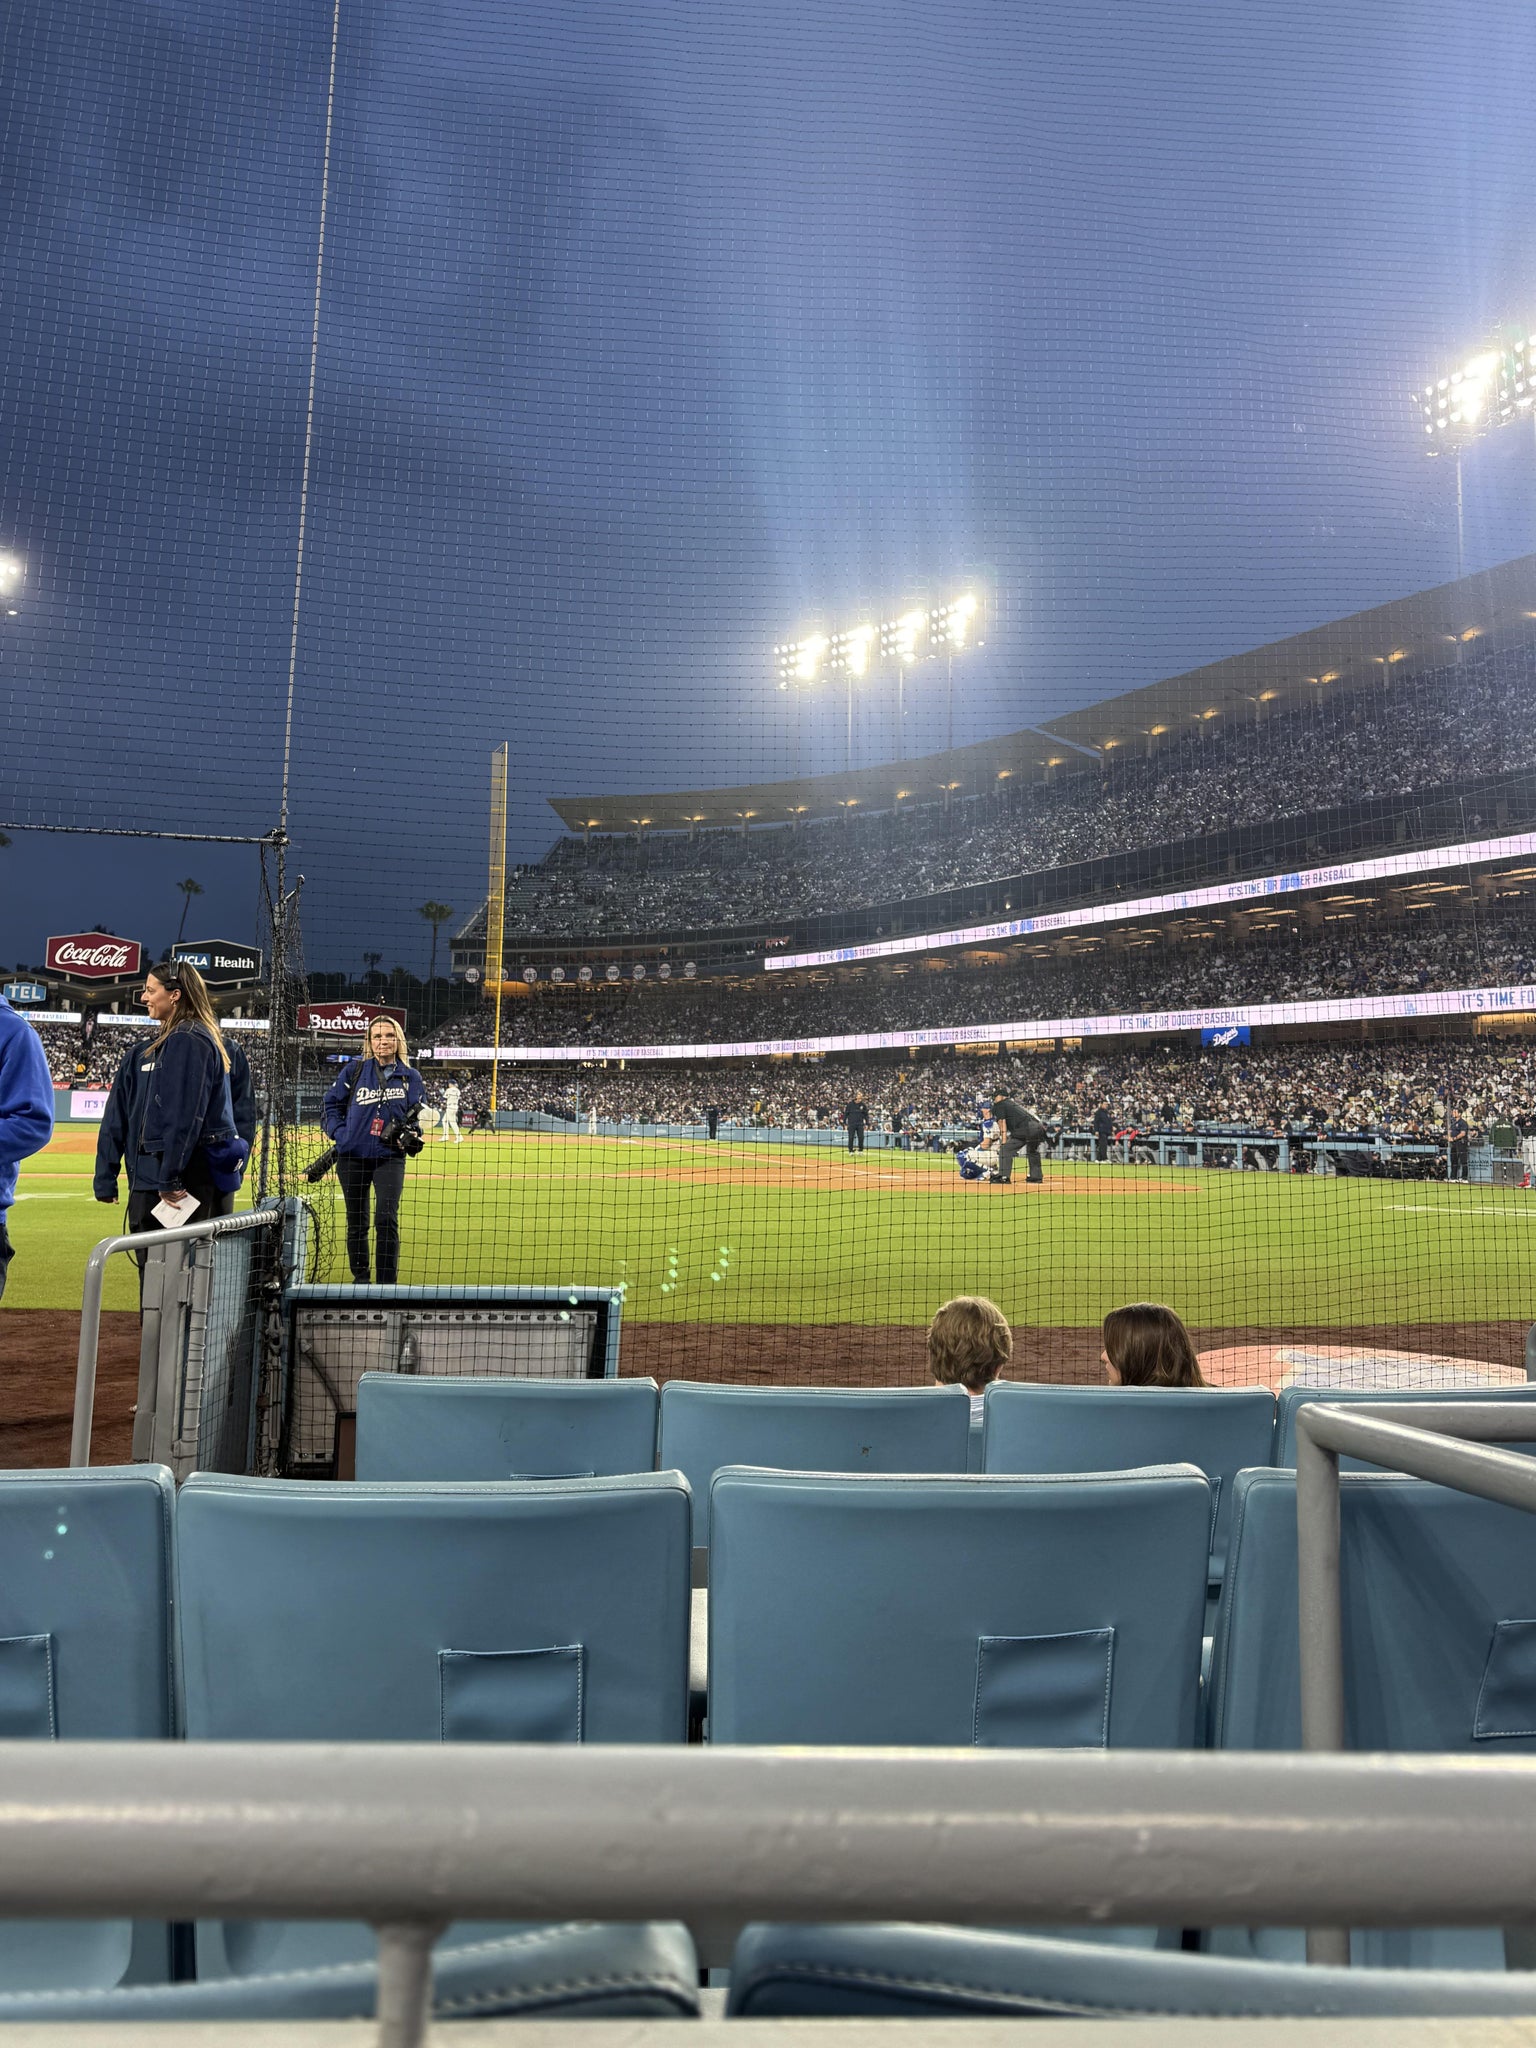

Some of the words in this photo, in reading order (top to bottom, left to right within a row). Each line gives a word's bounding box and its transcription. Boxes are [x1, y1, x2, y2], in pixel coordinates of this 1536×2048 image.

[1244, 883, 1260, 894] TIME
[1313, 868, 1353, 884] BASEBALL
[1040, 916, 1067, 928] BASEBALL
[55, 942, 132, 968] Coca-Cola
[214, 956, 254, 969] Health
[9, 985, 41, 999] TEL
[1462, 993, 1484, 1008] IT'S
[1488, 991, 1516, 1006] TIME
[1520, 990, 1536, 1004] FO
[308, 1014, 370, 1030] Budwei
[1120, 1019, 1133, 1029] IT'S
[1135, 1018, 1152, 1029] TIME
[1155, 1015, 1169, 1027] FOR
[1204, 1011, 1246, 1024] BASEBALL
